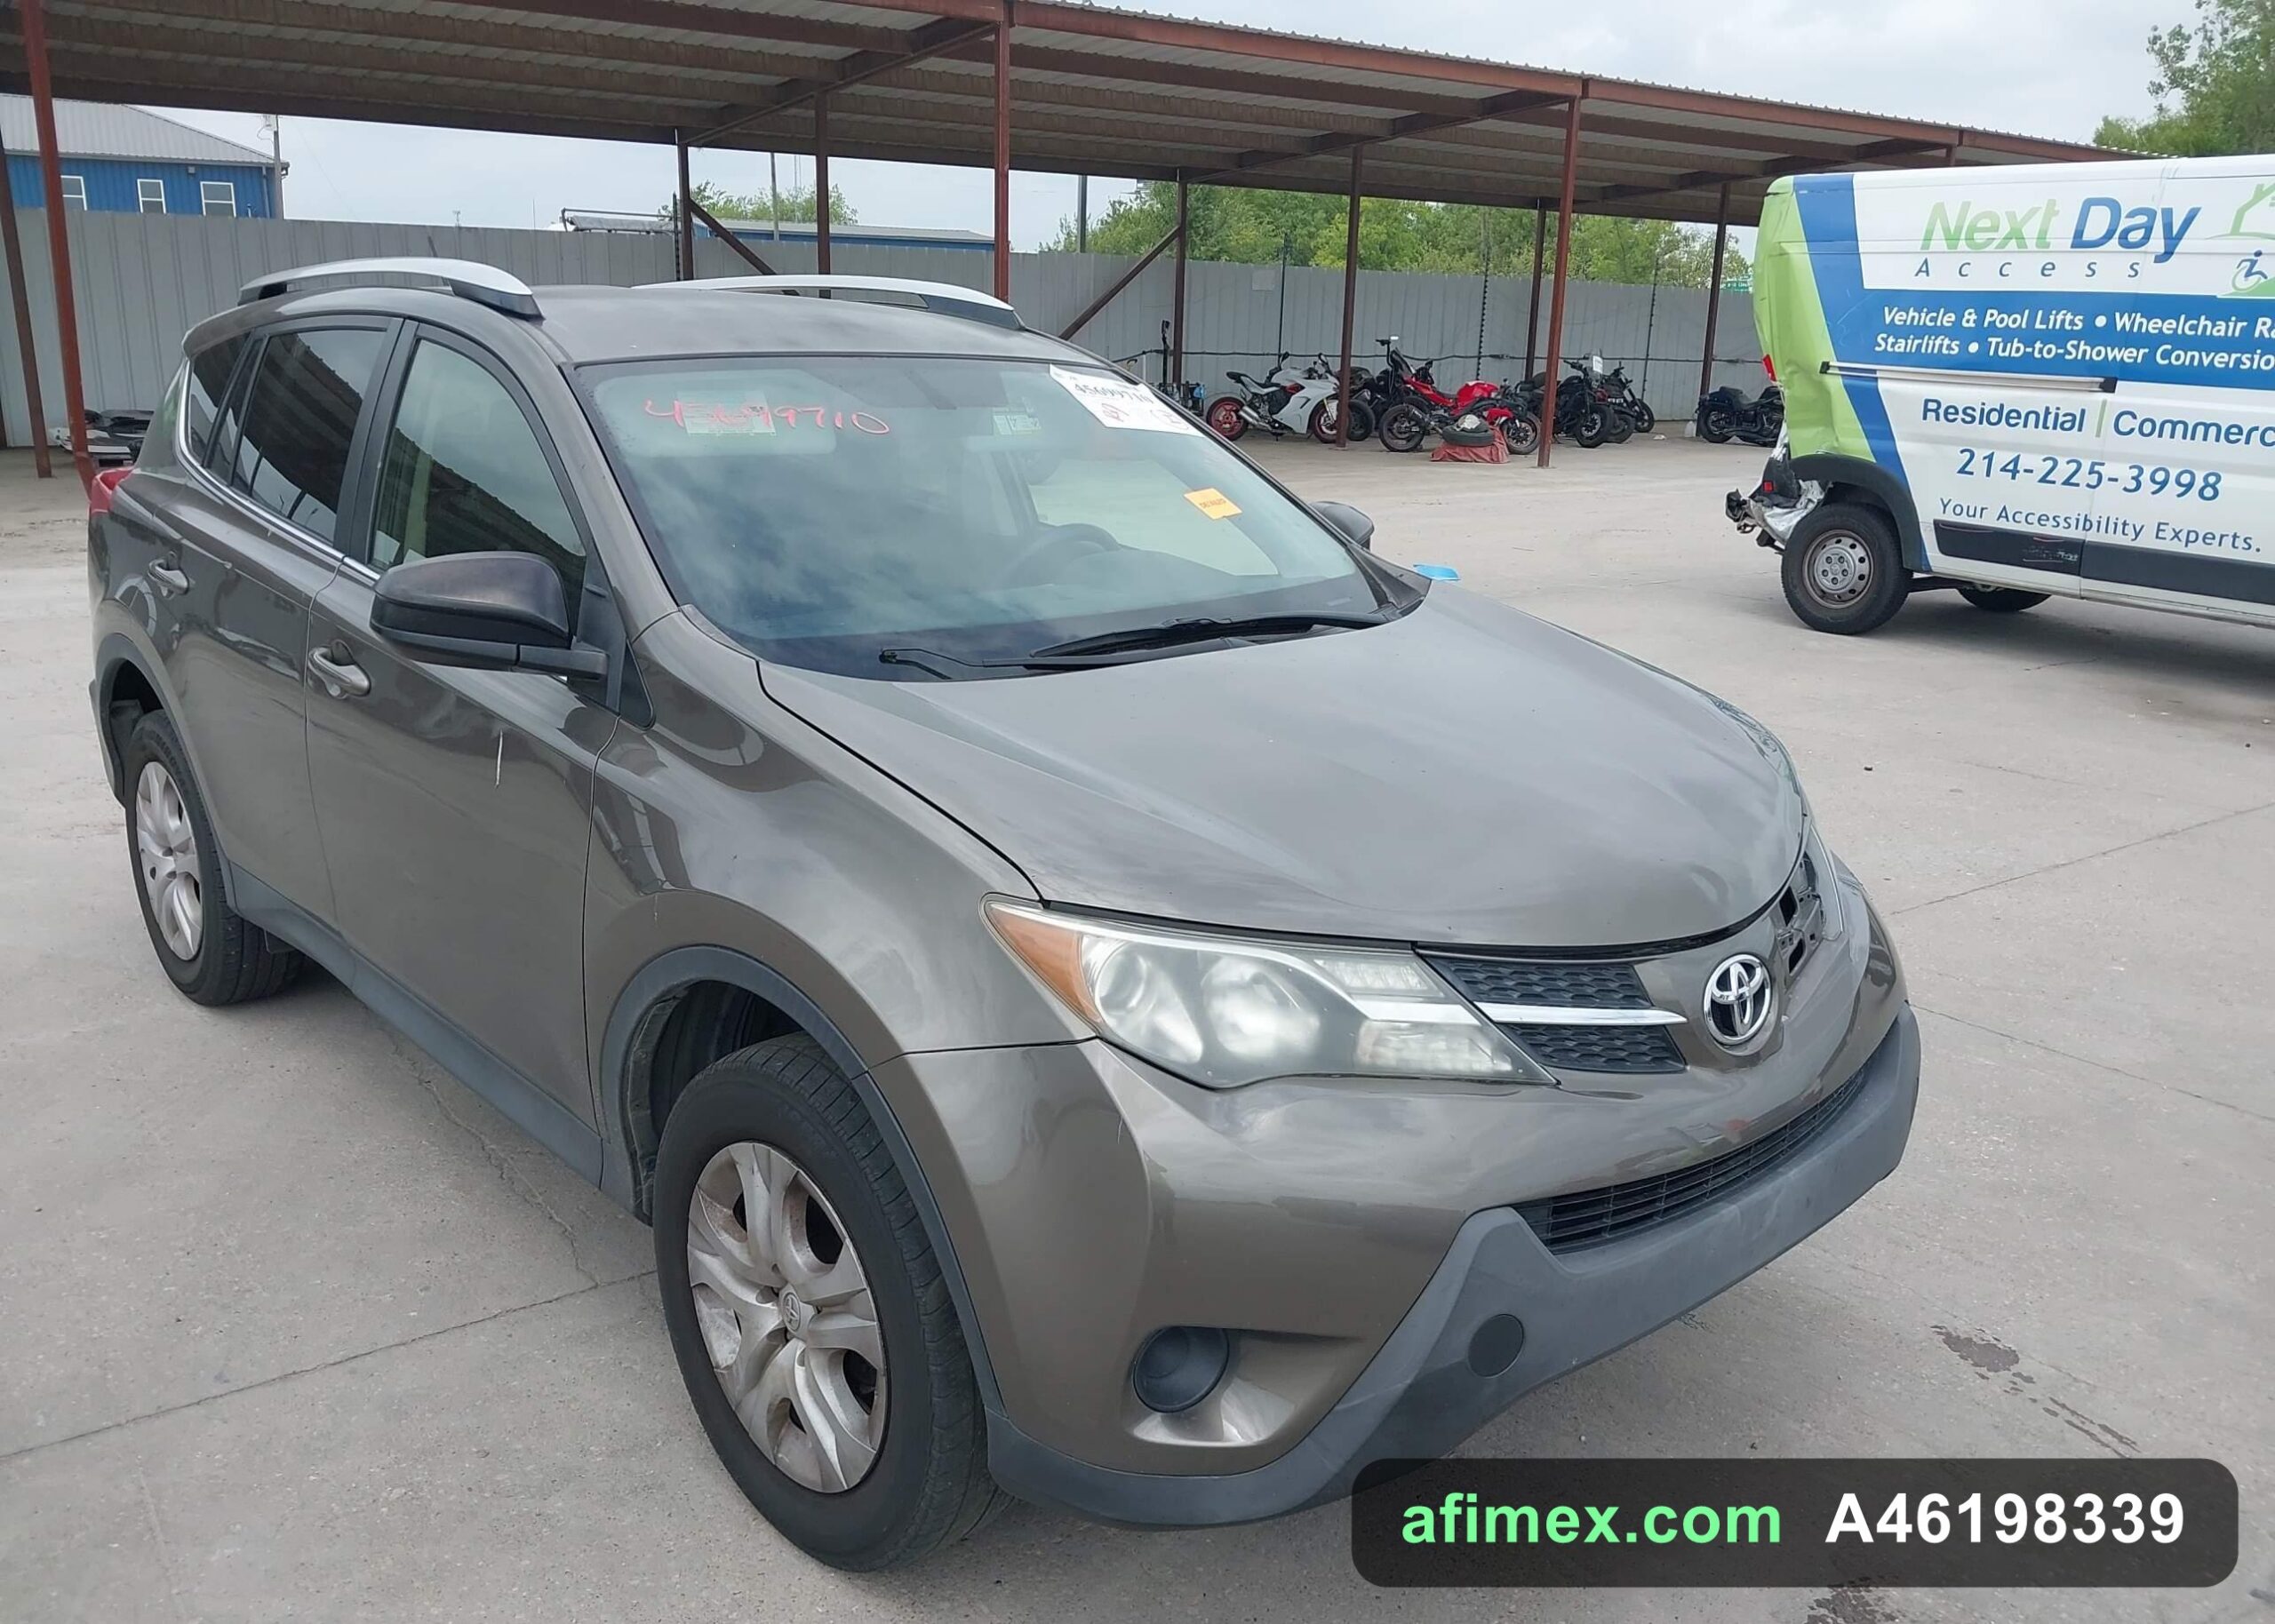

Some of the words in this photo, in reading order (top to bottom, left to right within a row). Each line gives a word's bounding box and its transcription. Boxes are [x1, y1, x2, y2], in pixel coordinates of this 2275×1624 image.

[1920, 198, 2060, 251] Next
[2070, 196, 2202, 264] Day
[1914, 257, 2140, 278] Access
[1883, 306, 1956, 327] Vehicle
[1961, 308, 1978, 328] &
[1983, 309, 2031, 329] Pool
[2034, 309, 2084, 330] Lifts
[2114, 311, 2248, 338] Wheelchair
[1874, 332, 1960, 354] Stairlifts
[1987, 337, 2150, 363] Tub-to-Shower
[2155, 344, 2275, 370] Conversio
[1921, 398, 2087, 433] Residential
[2113, 410, 2275, 446] Commerc
[1956, 447, 2223, 502] 214-225-3998
[1940, 497, 1989, 519] Your
[1996, 505, 2145, 541] Accessibility
[2155, 521, 2262, 553] Experts.
